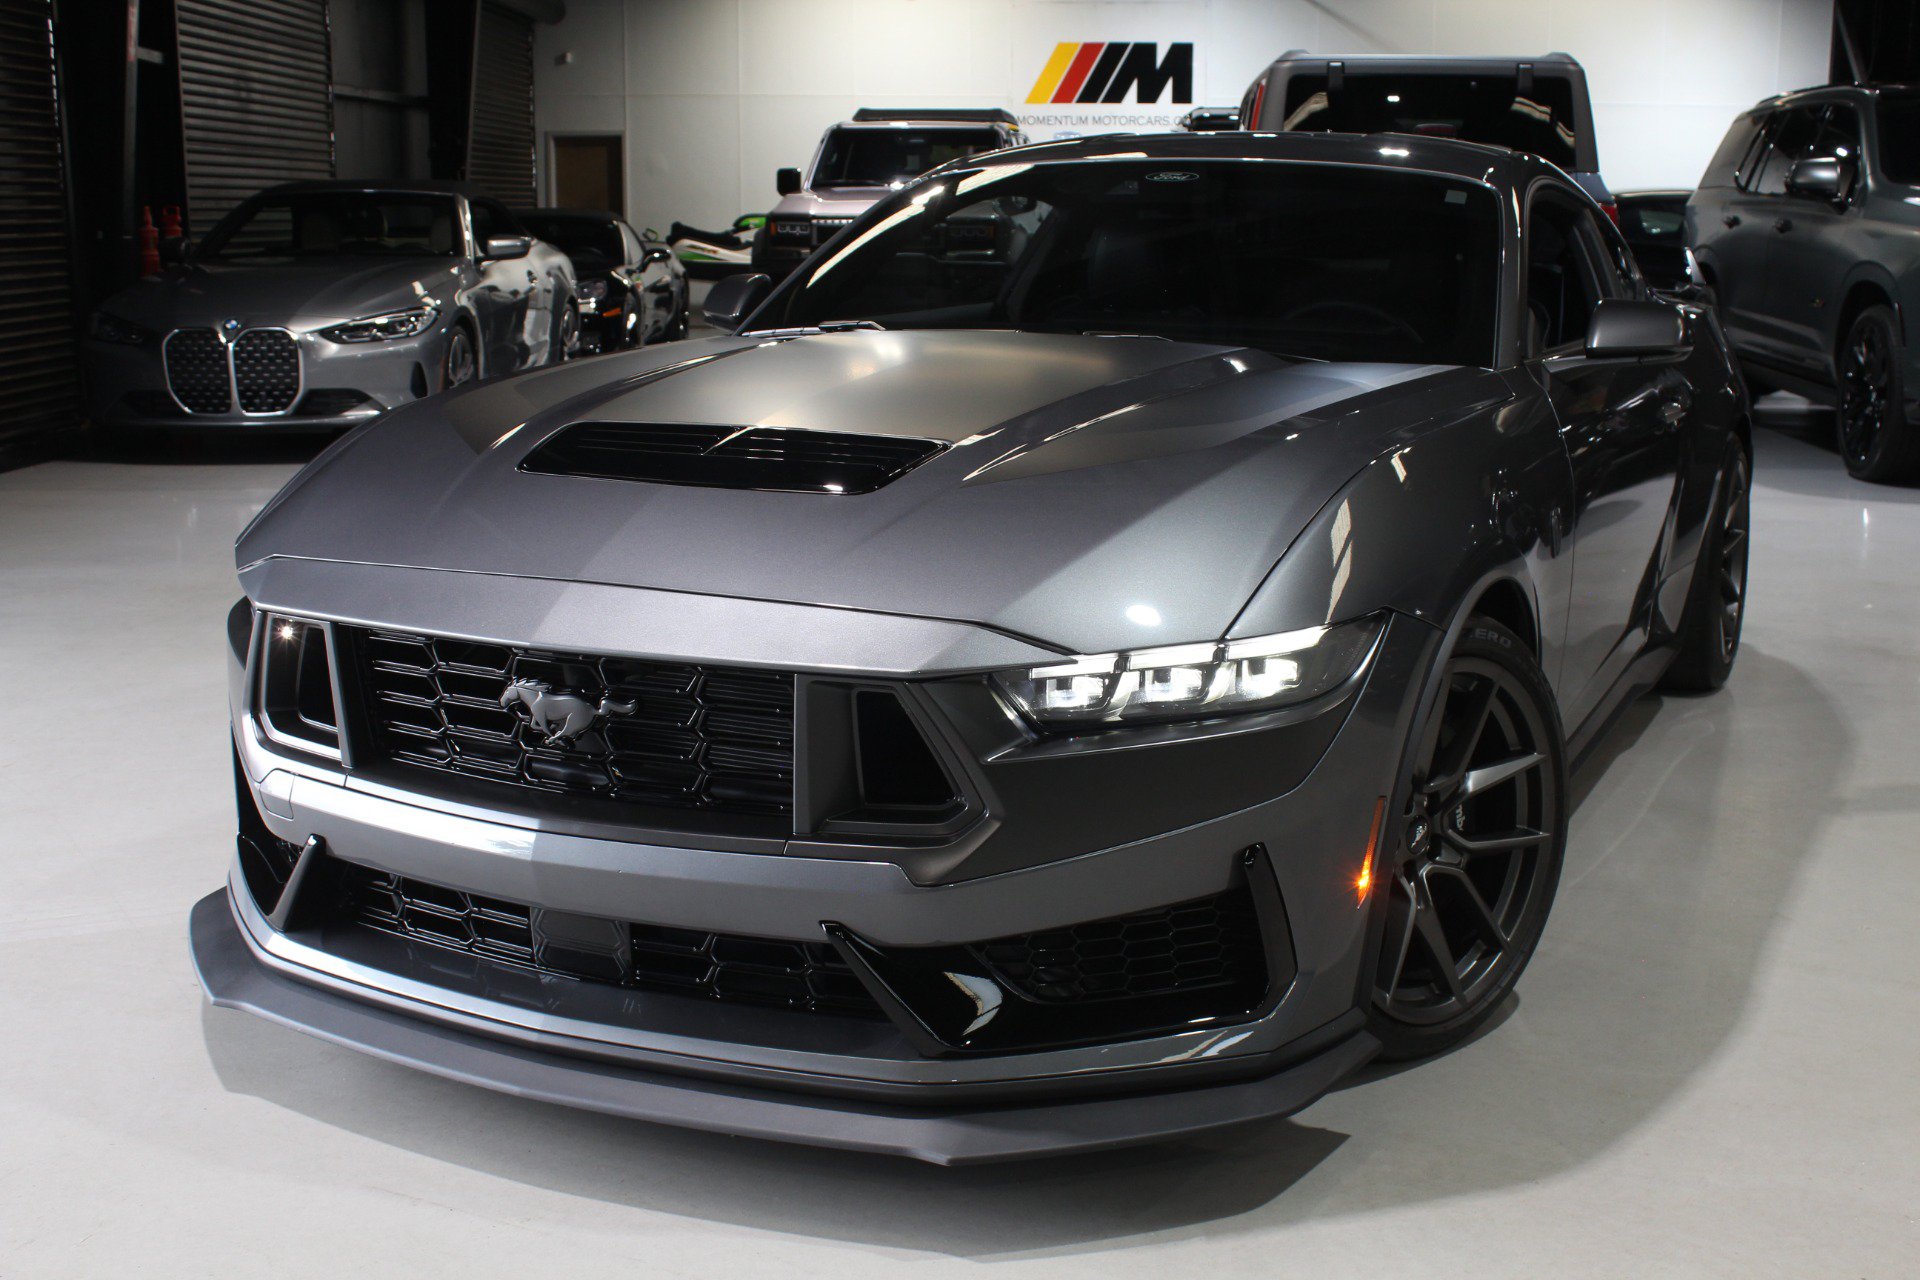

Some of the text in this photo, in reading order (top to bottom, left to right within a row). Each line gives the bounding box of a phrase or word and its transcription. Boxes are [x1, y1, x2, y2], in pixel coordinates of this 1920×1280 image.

[1017, 115, 1088, 126] MOMENTUM
[1151, 172, 1192, 181] Ford
[1470, 628, 1511, 648] ERO
